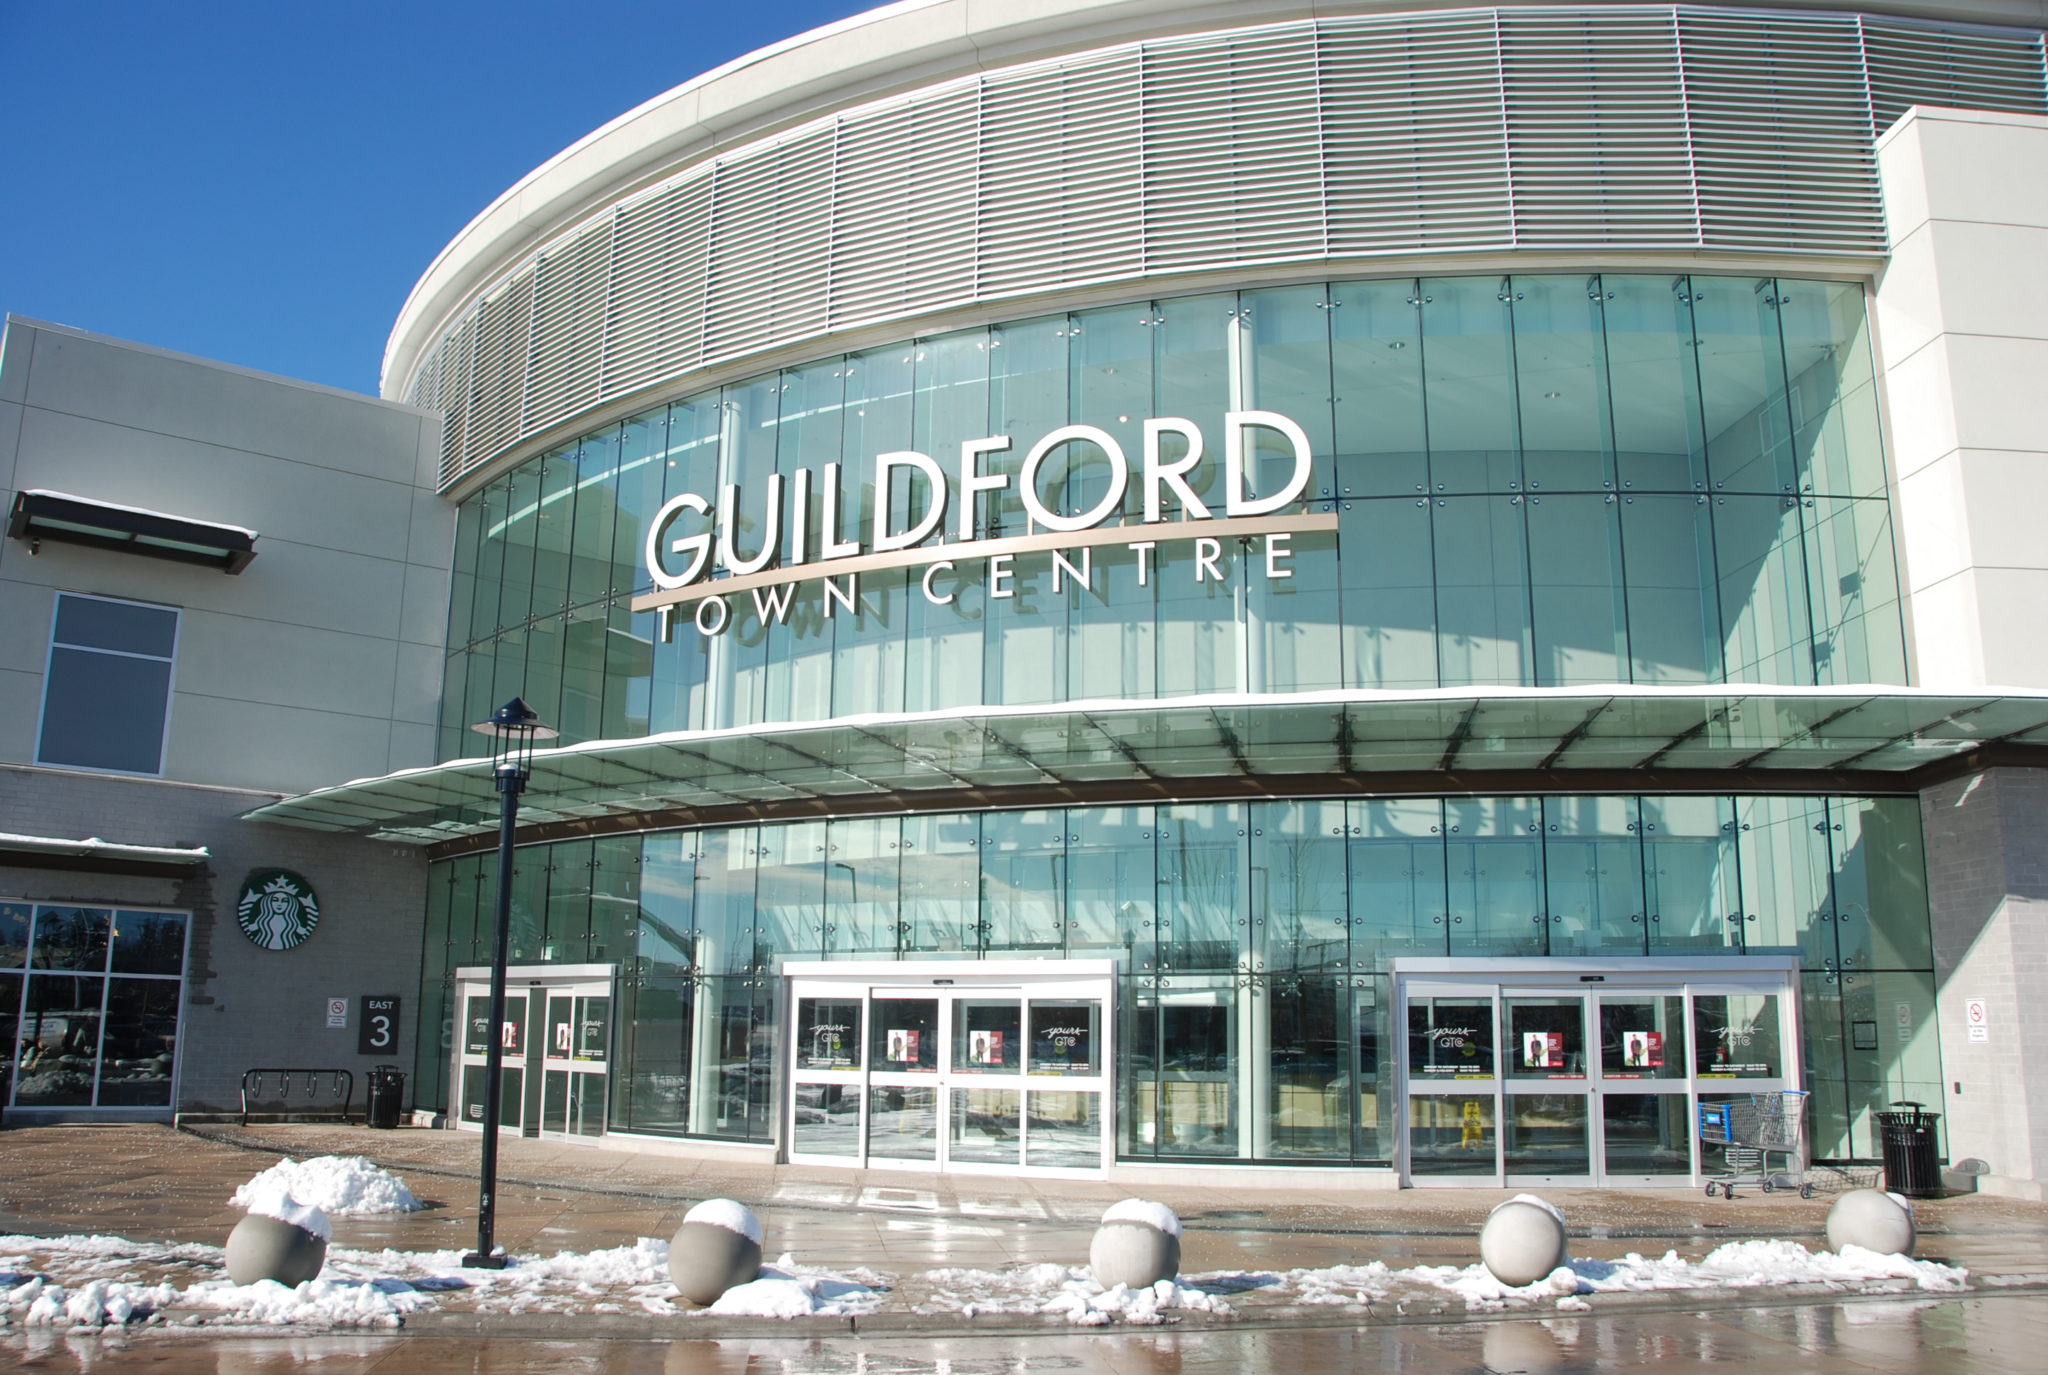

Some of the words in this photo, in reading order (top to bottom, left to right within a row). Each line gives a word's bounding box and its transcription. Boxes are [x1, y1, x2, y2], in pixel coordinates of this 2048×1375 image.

[645, 409, 1313, 590] GUILDFORD
[655, 572, 861, 644] TOWN
[921, 532, 1294, 606] CENTRE
[368, 999, 395, 1010] EAST
[369, 1015, 391, 1048] 3
